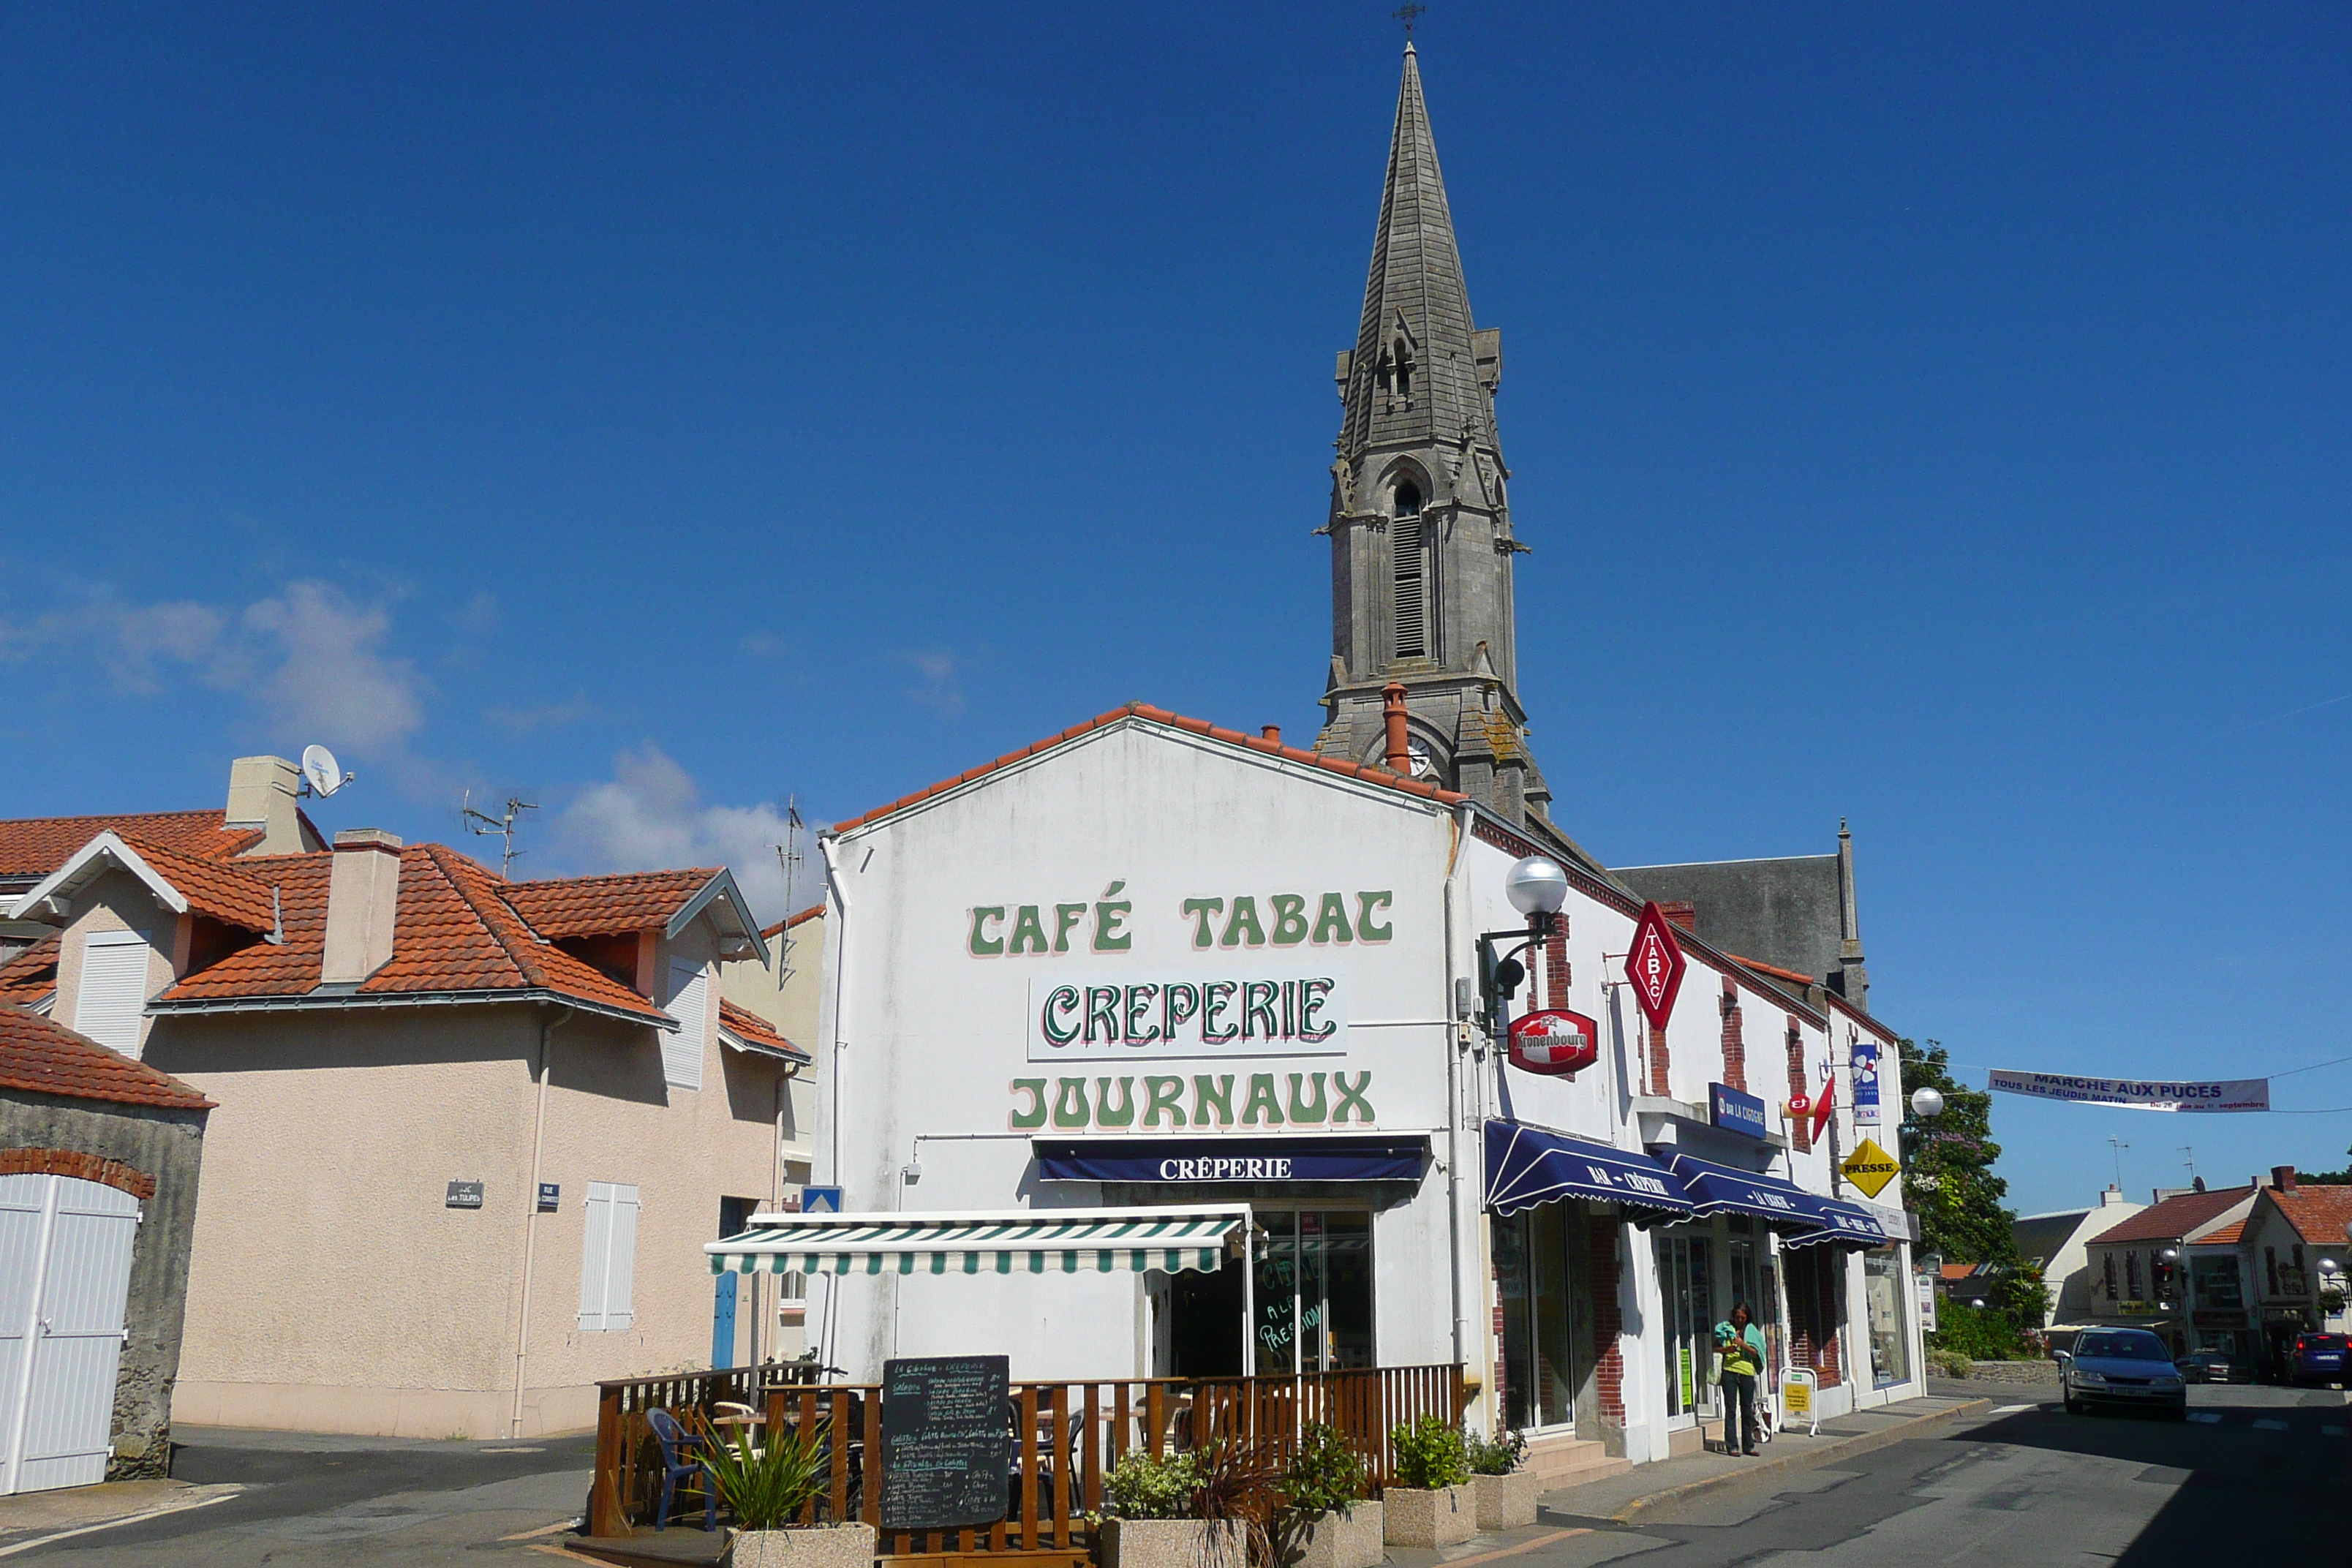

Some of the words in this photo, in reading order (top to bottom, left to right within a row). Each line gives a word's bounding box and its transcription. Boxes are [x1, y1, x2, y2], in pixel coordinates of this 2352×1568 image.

[968, 880, 1132, 958] CAFÉ
[1180, 890, 1392, 951] TABAC
[1646, 935, 1661, 998] TABAC
[1040, 977, 1338, 1048] CREPERIE
[1517, 1030, 1586, 1049] Kronenbourg
[1994, 1079, 2023, 1090] TOUS
[2026, 1084, 2046, 1093] LES
[2048, 1088, 2089, 1100] JEUDIS
[2092, 1094, 2126, 1104] MATIN
[2035, 1074, 2111, 1093] MARCHE
[2117, 1082, 2155, 1097] AUX
[2160, 1085, 2222, 1098] PUCES
[1008, 1071, 1376, 1132] JOURNAUX
[2219, 1101, 2266, 1110] septembre
[1160, 1157, 1292, 1180] CRÊPERIE
[1586, 1166, 1613, 1185] BAR
[1844, 1164, 1893, 1174] PRESSE
[1267, 1305, 1278, 1319] A
